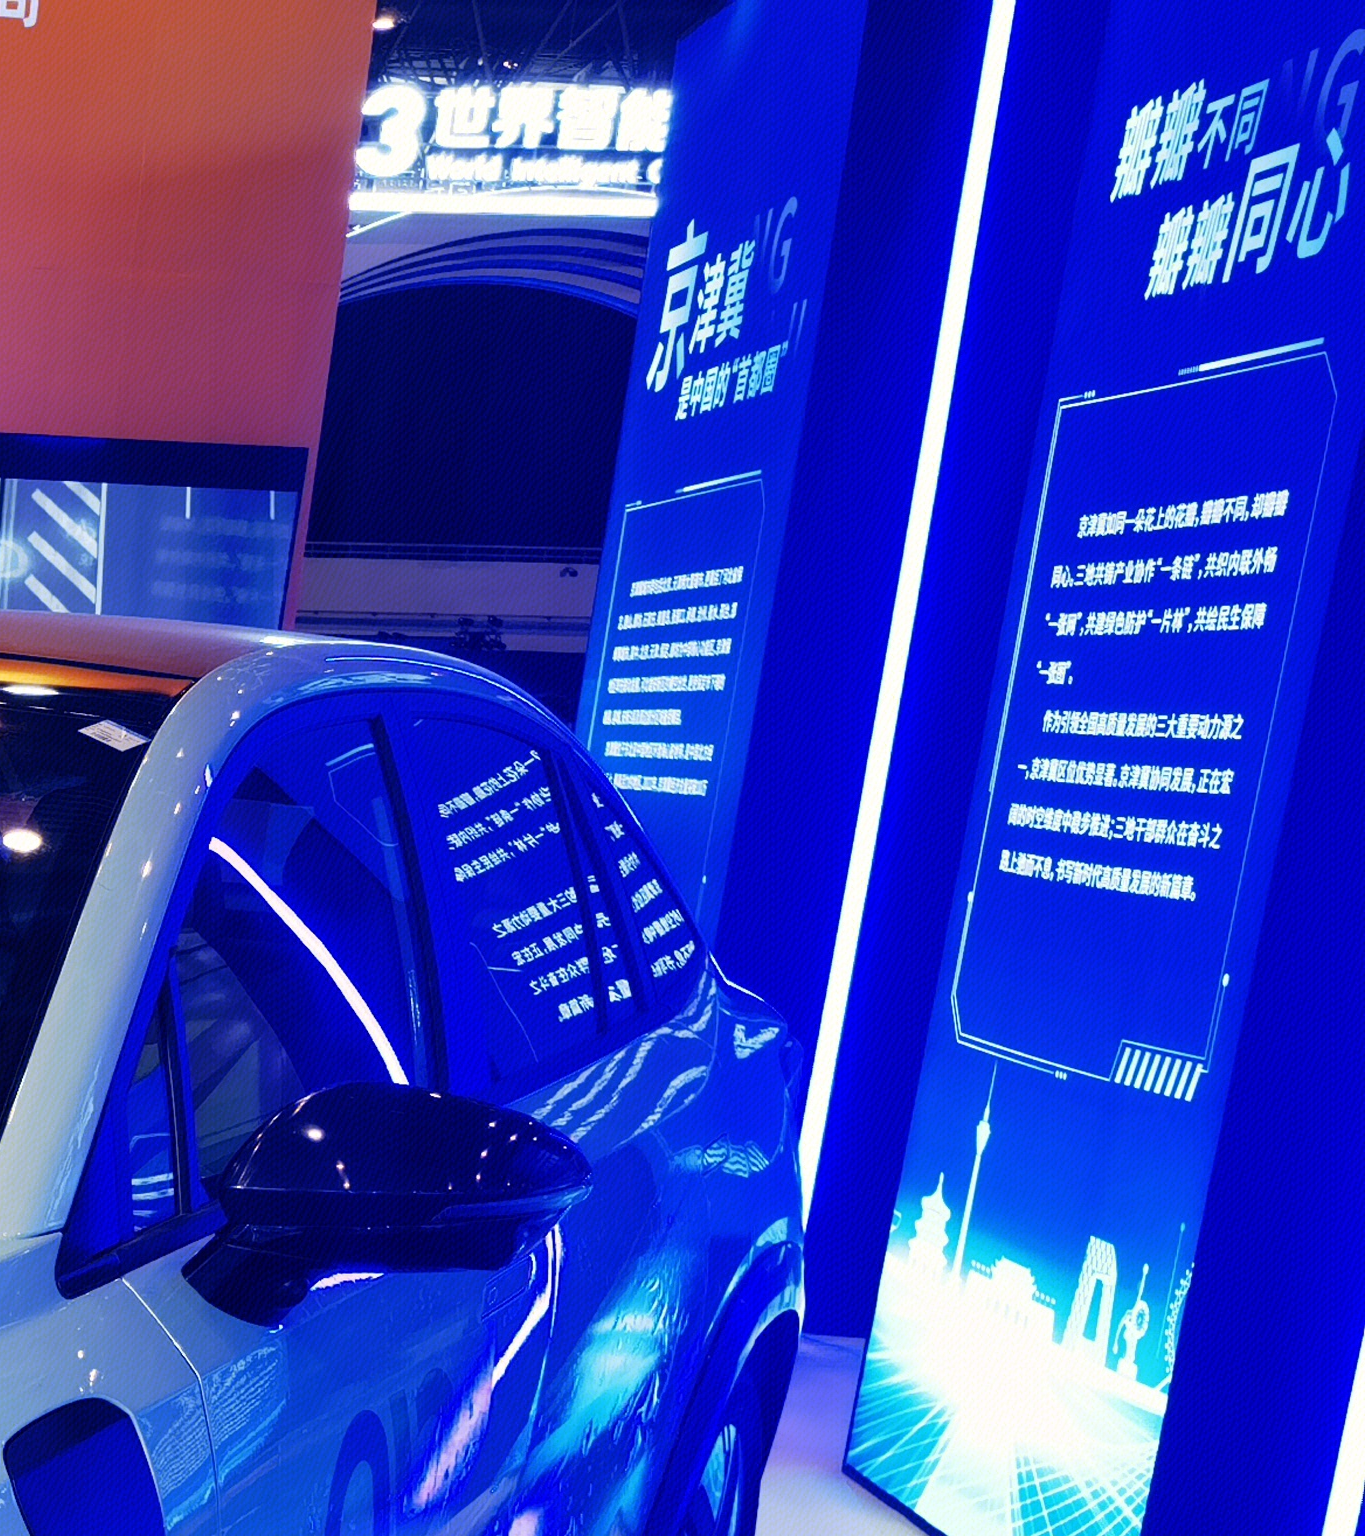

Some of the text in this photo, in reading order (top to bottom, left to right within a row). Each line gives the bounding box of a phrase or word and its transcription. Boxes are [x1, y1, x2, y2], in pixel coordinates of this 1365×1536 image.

[1110, 78, 1270, 204] 瓣瓣不同
[1144, 126, 1351, 301] 瓣瓣同心
[646, 218, 756, 393] 京津冀
